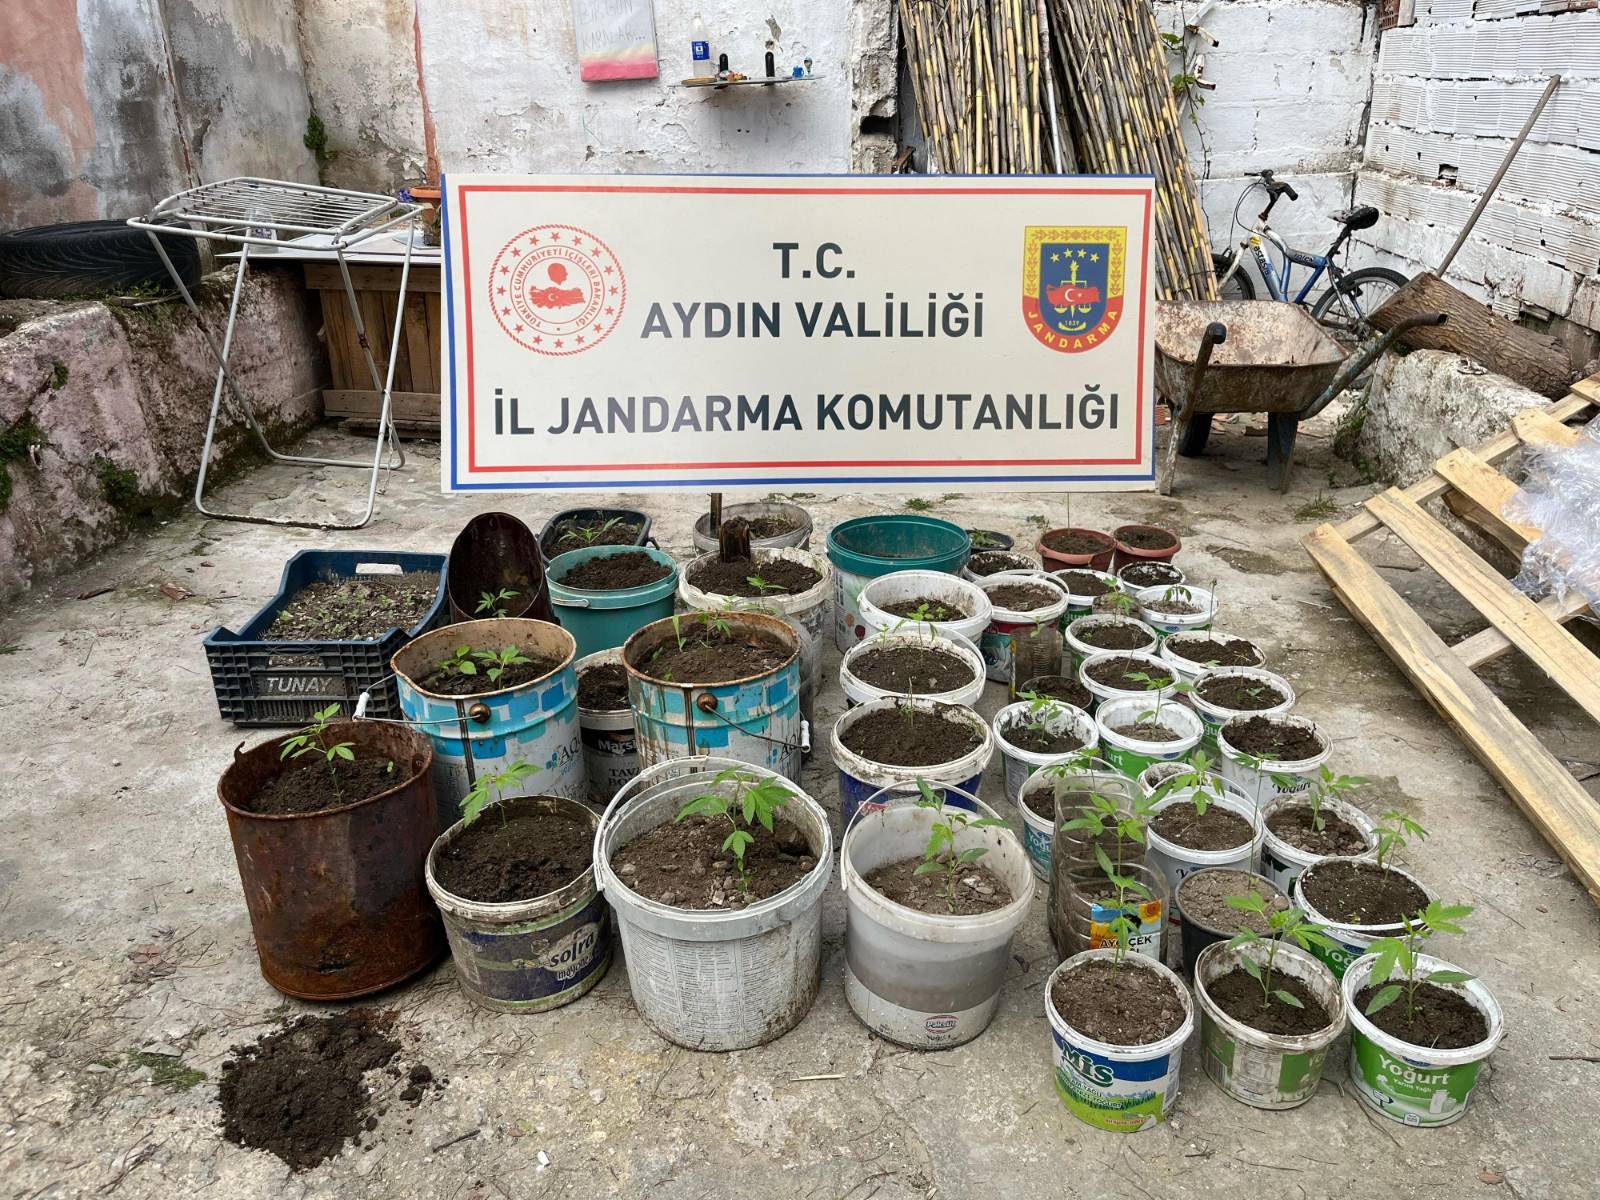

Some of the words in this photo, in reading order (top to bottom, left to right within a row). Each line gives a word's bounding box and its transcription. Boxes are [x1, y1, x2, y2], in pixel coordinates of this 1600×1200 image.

[513, 247, 562, 291] CUMHURİYETİ
[564, 249, 598, 279] İÇİŞLERİ
[773, 242, 855, 279] T.C.
[515, 294, 542, 328] TÜRKİYE
[574, 281, 602, 328] BAKANLIĞI
[640, 302, 780, 338] AYDIN
[795, 292, 983, 338] VALİLİĞİ
[1028, 311, 1118, 349] JANDARMA
[494, 388, 535, 435] İL
[547, 394, 803, 435] JANDARMA
[817, 383, 1119, 431] KOMUTANLIĞI
[266, 677, 333, 693] TUNAY
[1379, 1054, 1450, 1085] Yoğurt
